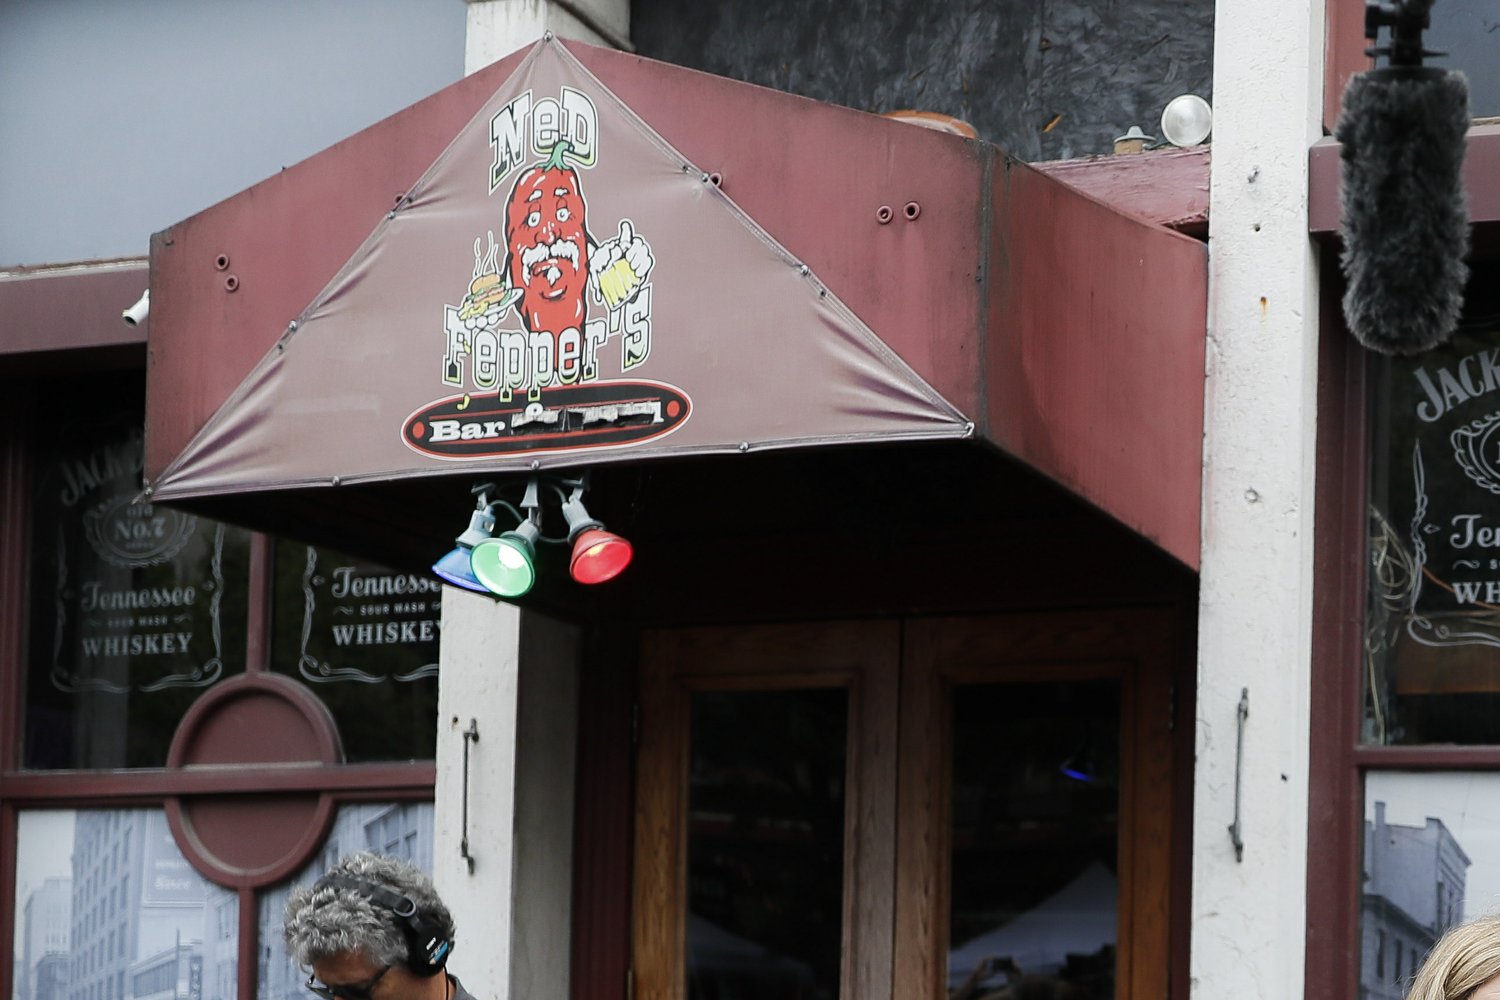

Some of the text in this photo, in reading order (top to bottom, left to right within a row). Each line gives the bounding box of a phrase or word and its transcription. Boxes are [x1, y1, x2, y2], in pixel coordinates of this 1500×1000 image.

[443, 284, 653, 403] Pepper's
[428, 419, 505, 443] Bar
[81, 580, 196, 612] Tennessee
[82, 632, 192, 657] WHISKEY
